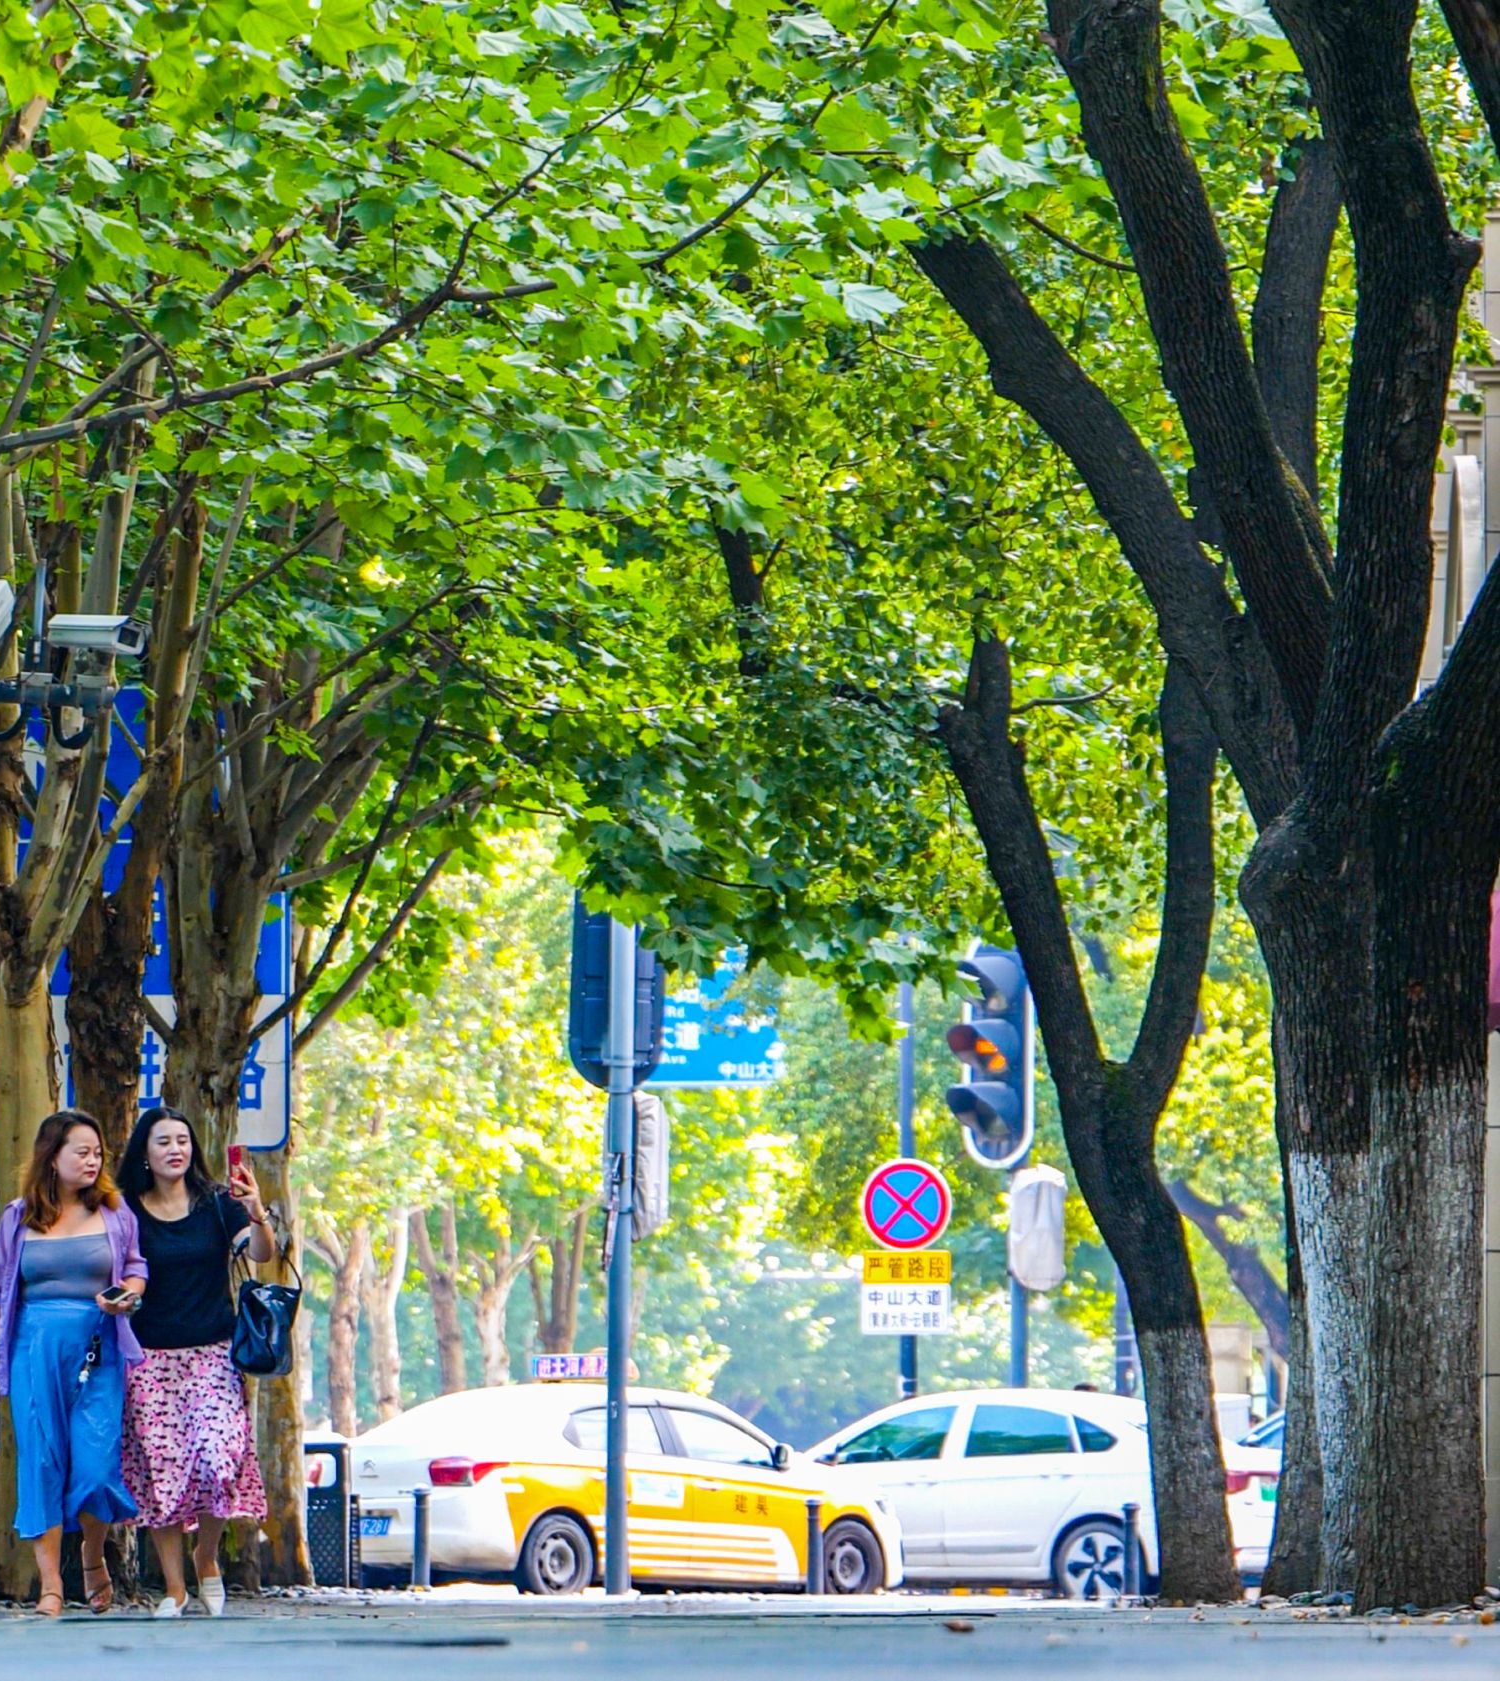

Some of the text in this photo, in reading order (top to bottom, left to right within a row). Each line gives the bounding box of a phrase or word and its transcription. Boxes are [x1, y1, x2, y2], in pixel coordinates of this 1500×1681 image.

[868, 1257, 945, 1278] 严管路段
[868, 1290, 941, 1305] 中山大道
